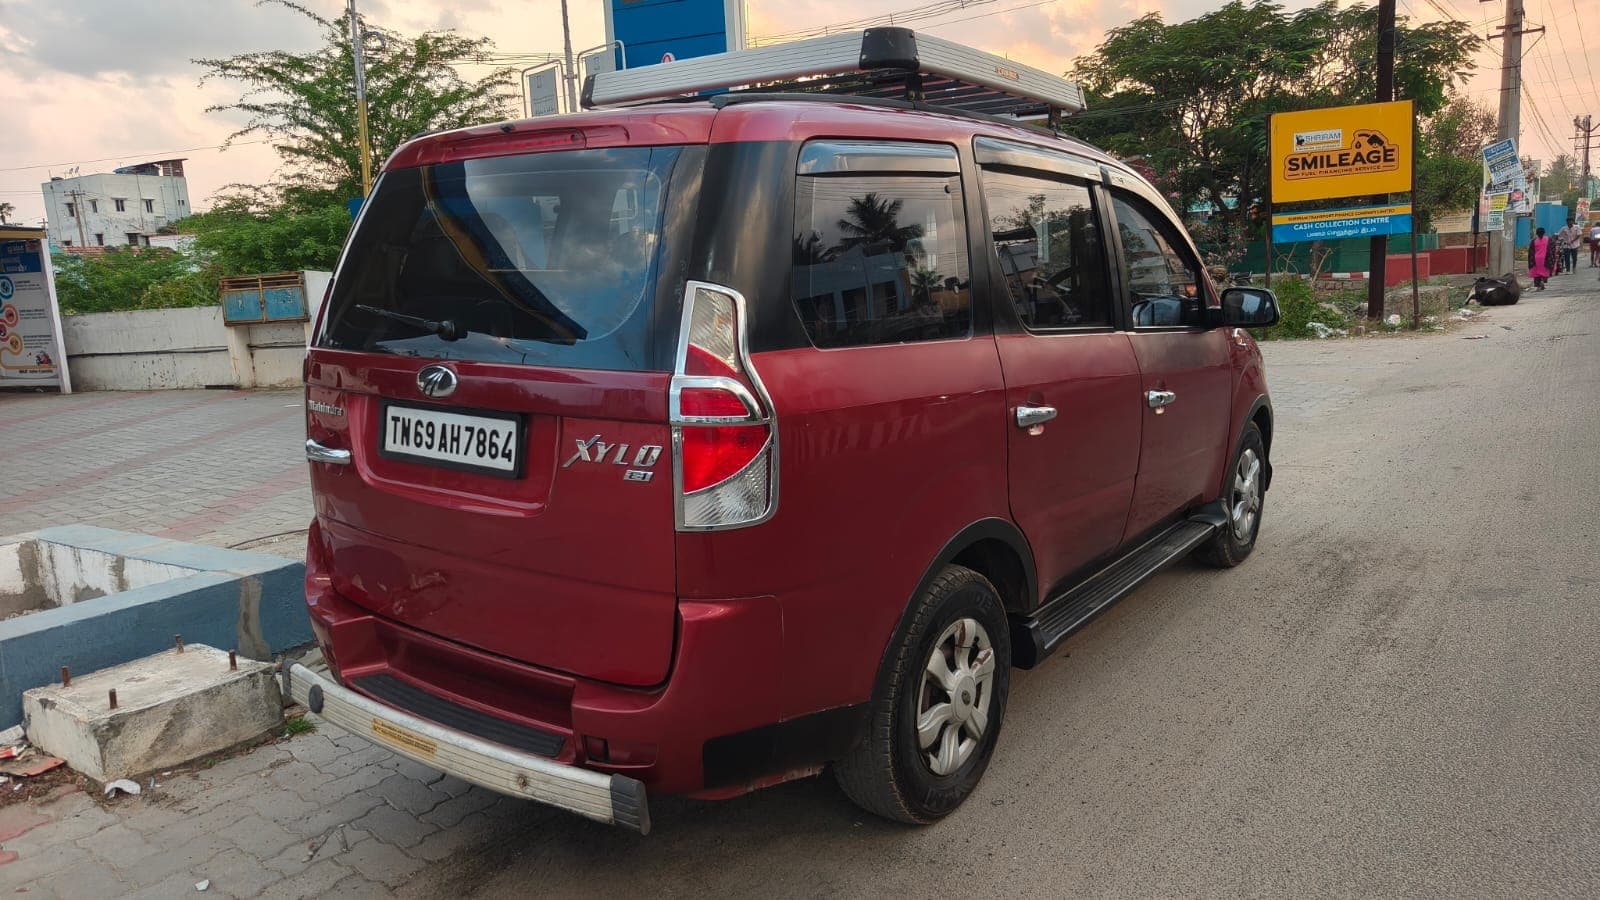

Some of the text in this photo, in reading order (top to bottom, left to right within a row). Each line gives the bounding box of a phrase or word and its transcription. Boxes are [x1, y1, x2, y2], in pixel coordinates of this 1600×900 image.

[1305, 132, 1341, 143] SHRIRAM
[1287, 146, 1396, 171] SMILEAGE
[1293, 217, 1389, 231] CASH COLLECTION CENTRE
[307, 400, 342, 416] Mahindra
[391, 415, 513, 463] TN69AH7864
[561, 434, 663, 468] XYLO
